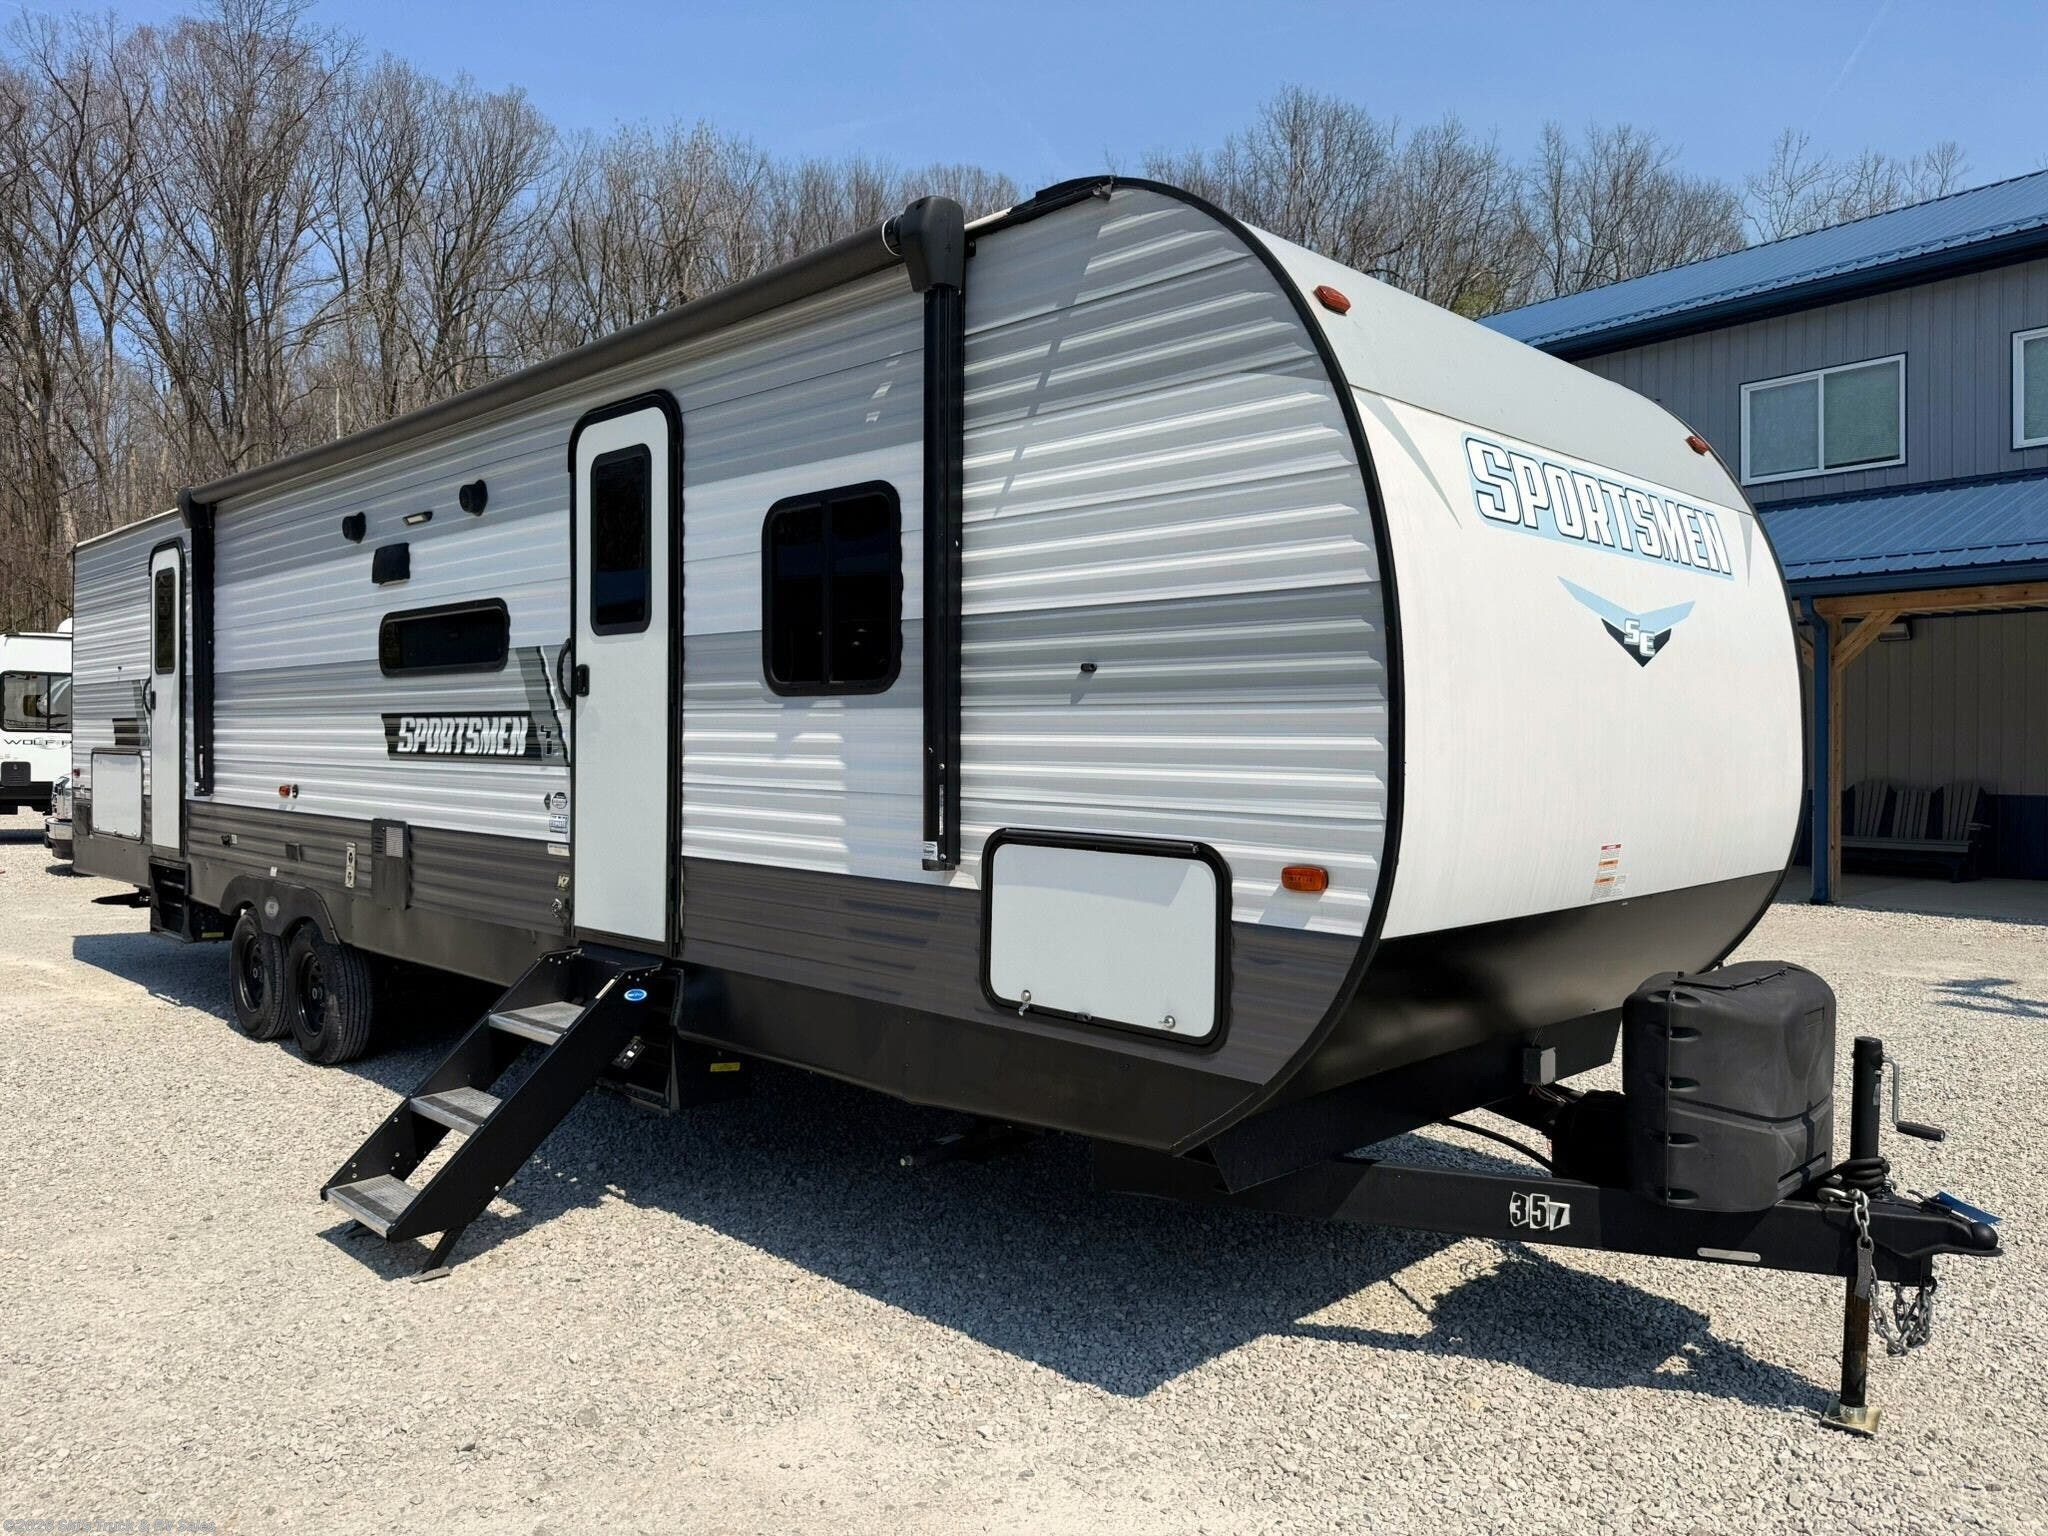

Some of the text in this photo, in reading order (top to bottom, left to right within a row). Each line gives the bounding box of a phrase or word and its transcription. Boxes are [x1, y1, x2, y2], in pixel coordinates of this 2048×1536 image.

[1465, 437, 1732, 575] SPORTSMEN
[1624, 618, 1656, 657] SE
[397, 716, 529, 756] SPORTSMEN
[1509, 1192, 1571, 1230] 357
